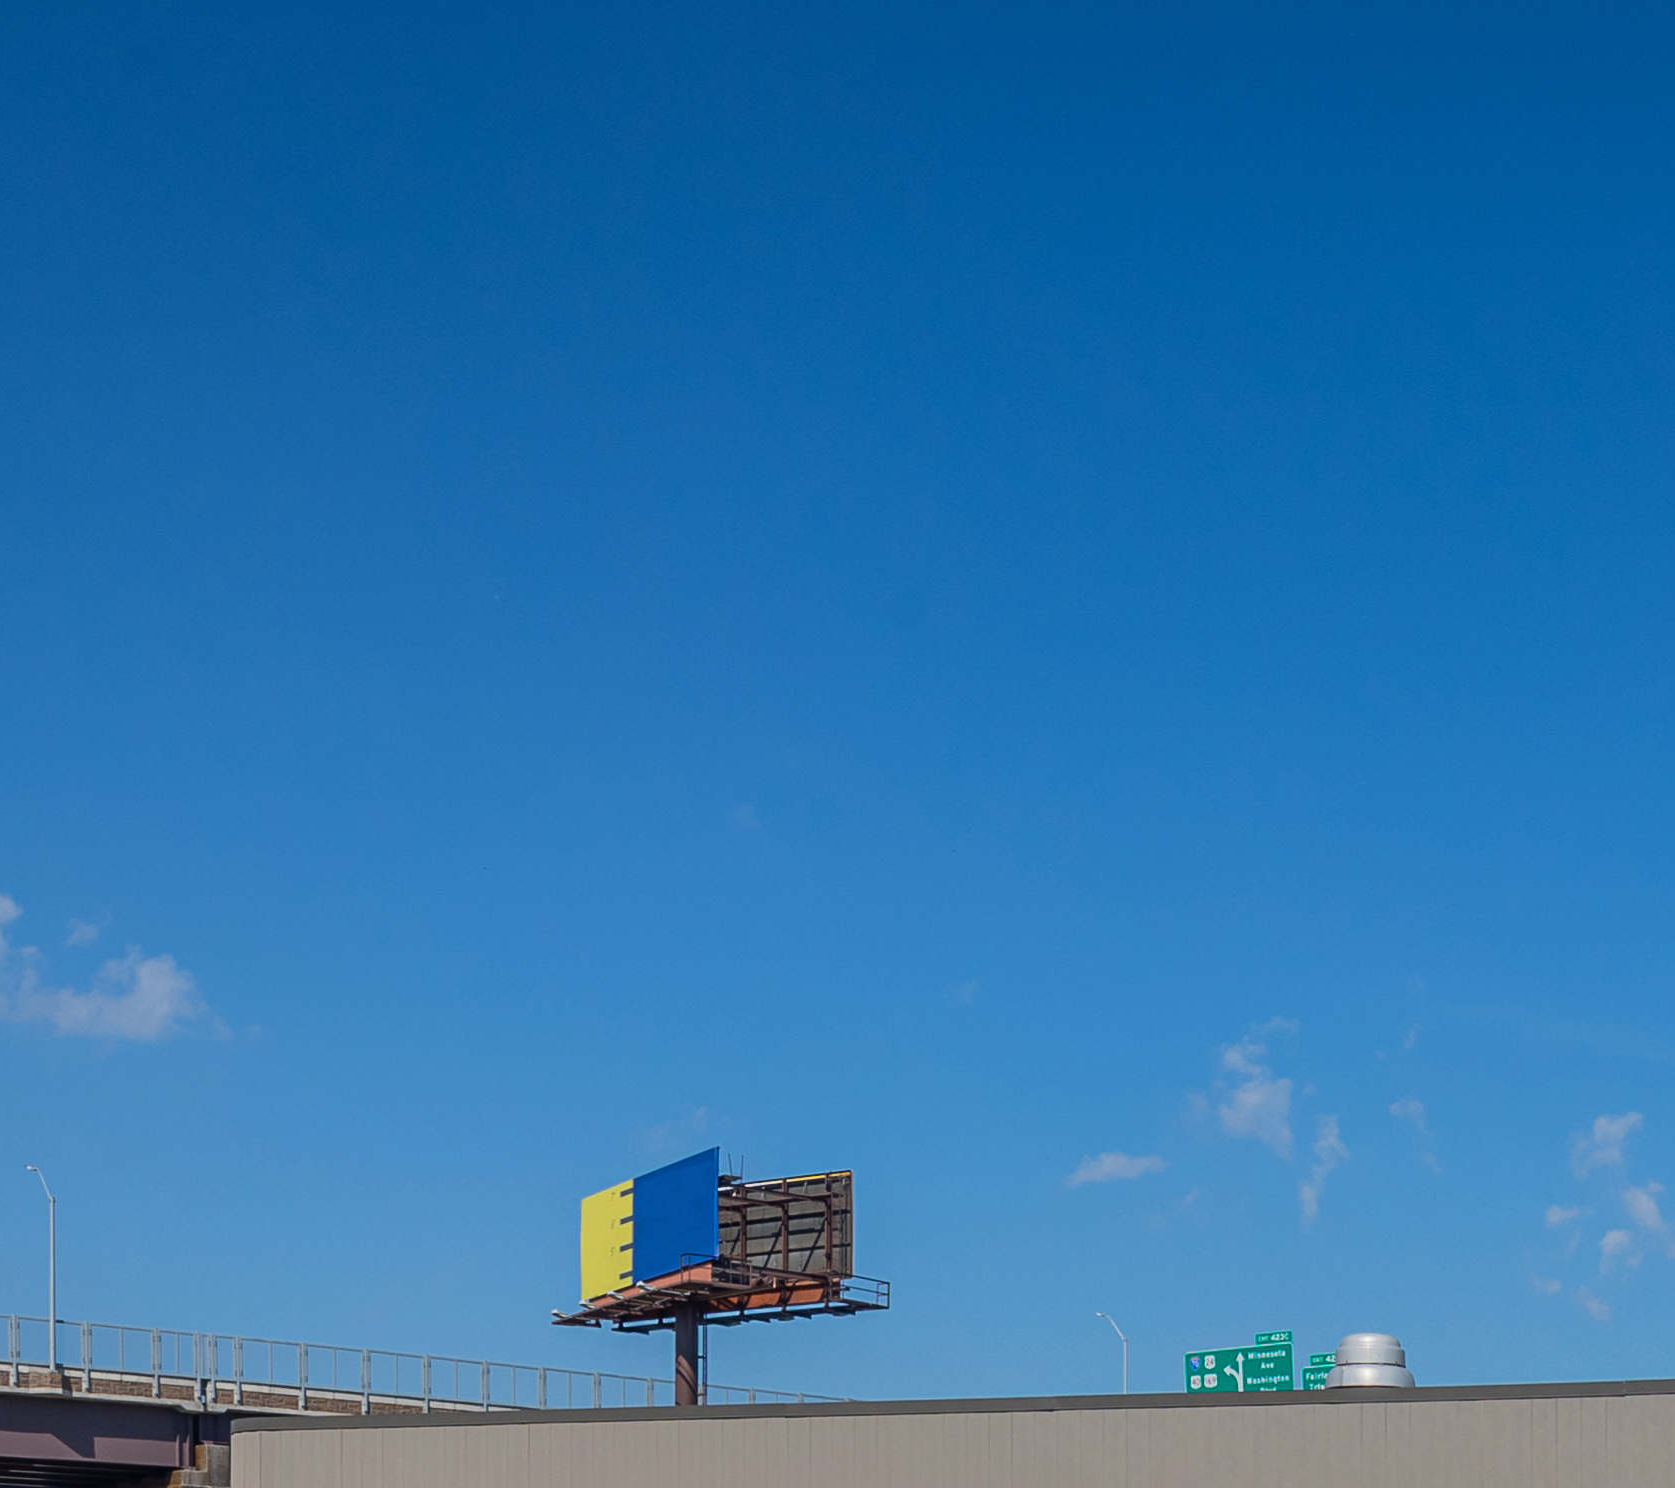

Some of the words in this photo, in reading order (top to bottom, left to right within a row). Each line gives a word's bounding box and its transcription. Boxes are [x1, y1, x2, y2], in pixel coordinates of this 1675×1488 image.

[1247, 1349, 1286, 1360] Minnesota
[1325, 1354, 1336, 1363] 42
[1260, 1361, 1274, 1369] Ave
[1247, 1374, 1290, 1385] Washington
[1306, 1371, 1328, 1380] Fairfa
